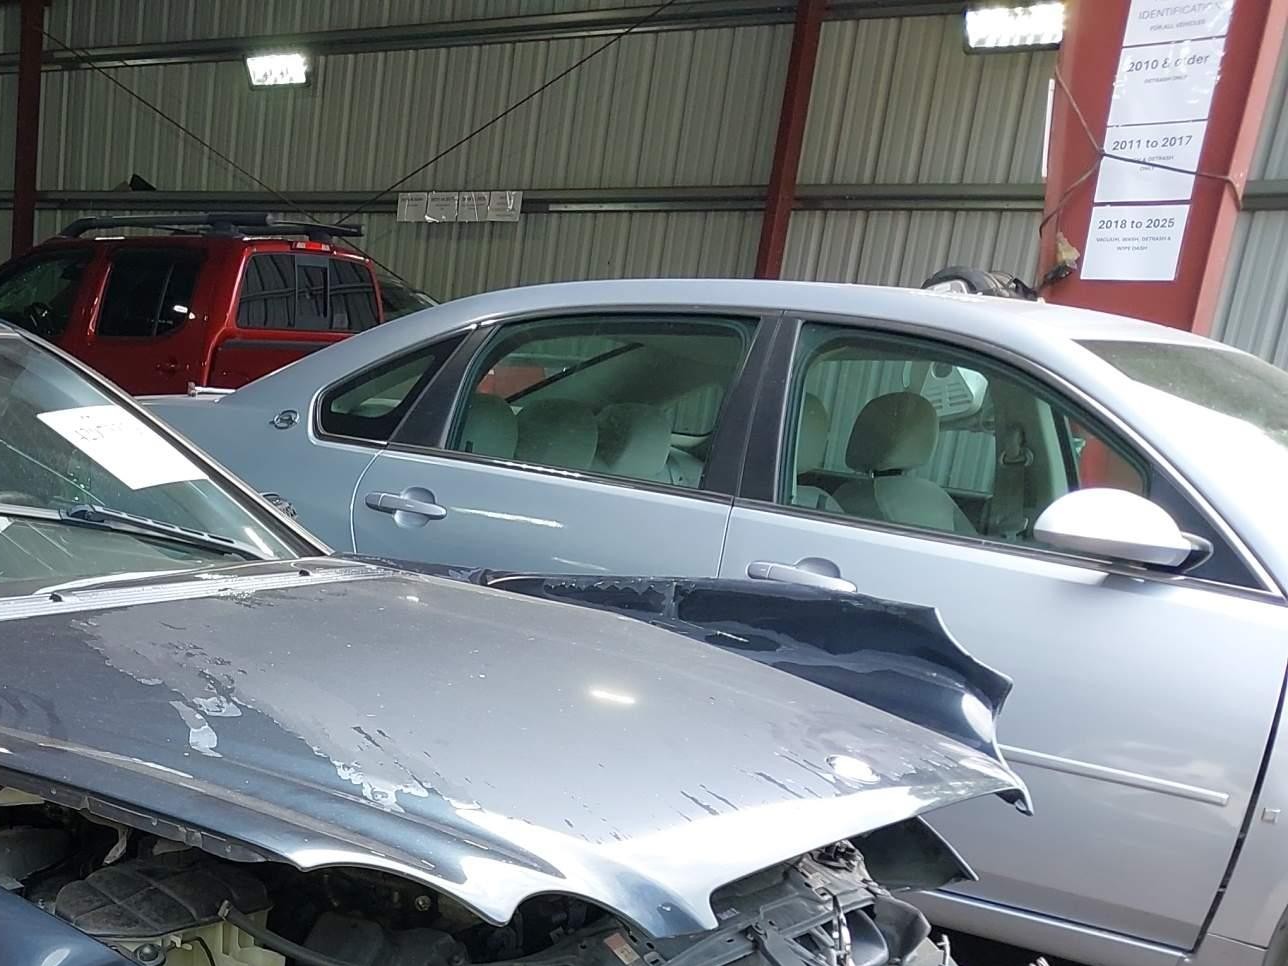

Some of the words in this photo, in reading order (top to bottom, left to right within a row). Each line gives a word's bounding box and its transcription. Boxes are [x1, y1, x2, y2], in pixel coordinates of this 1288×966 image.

[1138, 1, 1224, 20] IDENTIFICATI
[1127, 58, 1159, 73] 2010
[1175, 54, 1210, 68] oder
[1112, 139, 1141, 151] 2011
[1146, 139, 1158, 149] to
[1161, 135, 1193, 148] 2017
[1098, 219, 1127, 230] 2018
[1130, 220, 1142, 229] to
[1145, 217, 1175, 229] 2025
